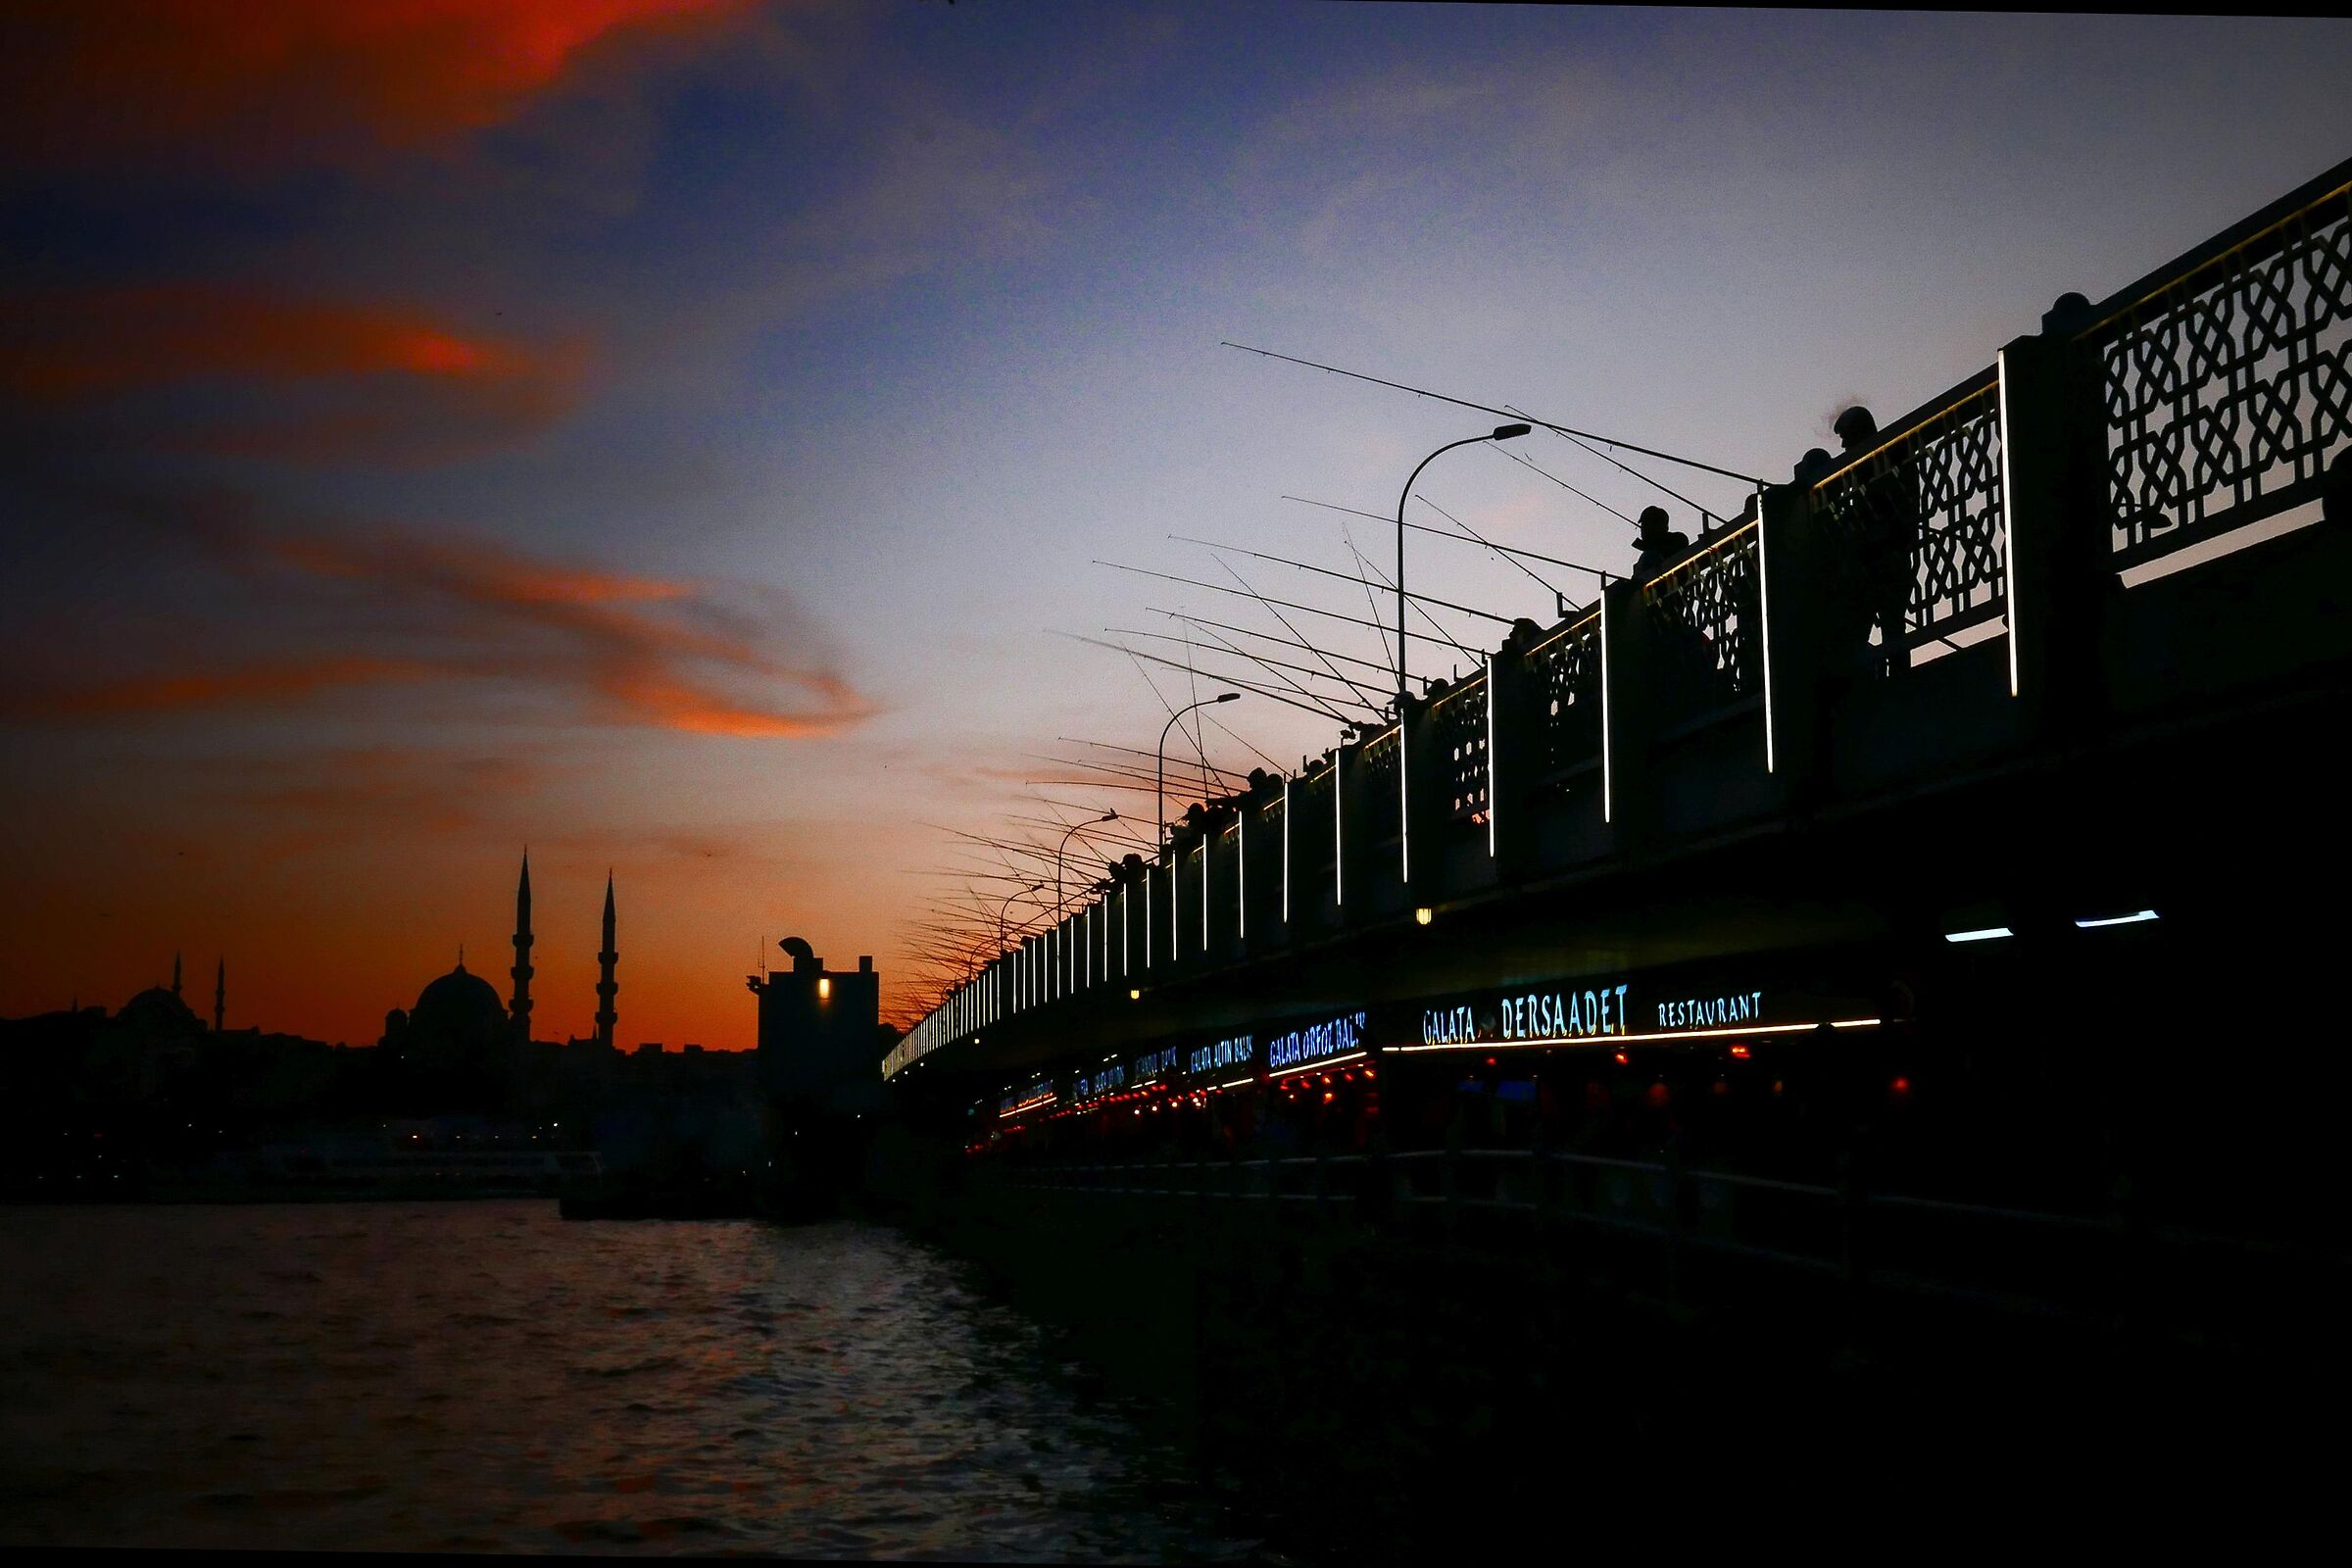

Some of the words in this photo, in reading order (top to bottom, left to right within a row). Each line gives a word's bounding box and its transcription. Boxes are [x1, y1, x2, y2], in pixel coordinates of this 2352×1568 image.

[1423, 1006, 1475, 1045] GALATA
[1501, 984, 1628, 1039] DERSAADET
[1658, 992, 1762, 1027] RESTAURANT
[1270, 1031, 1301, 1068] GALATA
[1302, 1021, 1334, 1059] ORFOZ
